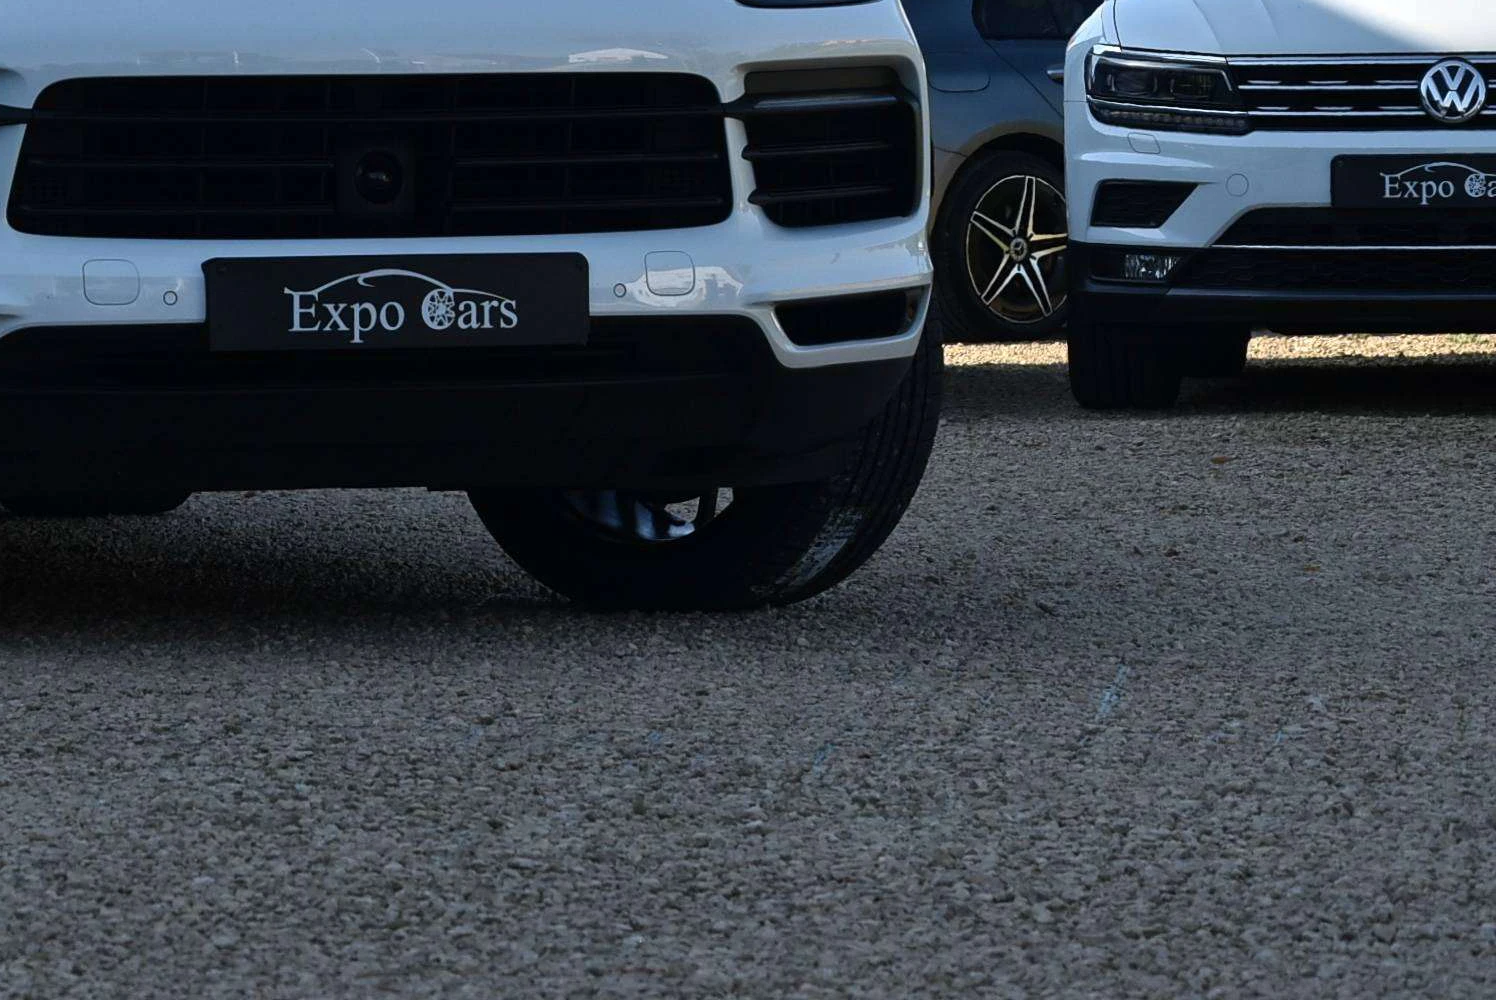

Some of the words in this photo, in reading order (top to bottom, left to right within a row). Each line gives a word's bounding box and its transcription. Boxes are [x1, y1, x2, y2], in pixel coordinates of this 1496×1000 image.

[1421, 60, 1485, 120] VW
[1383, 174, 1454, 205] Expo
[287, 290, 404, 343] Expo
[421, 288, 518, 331] Cars
